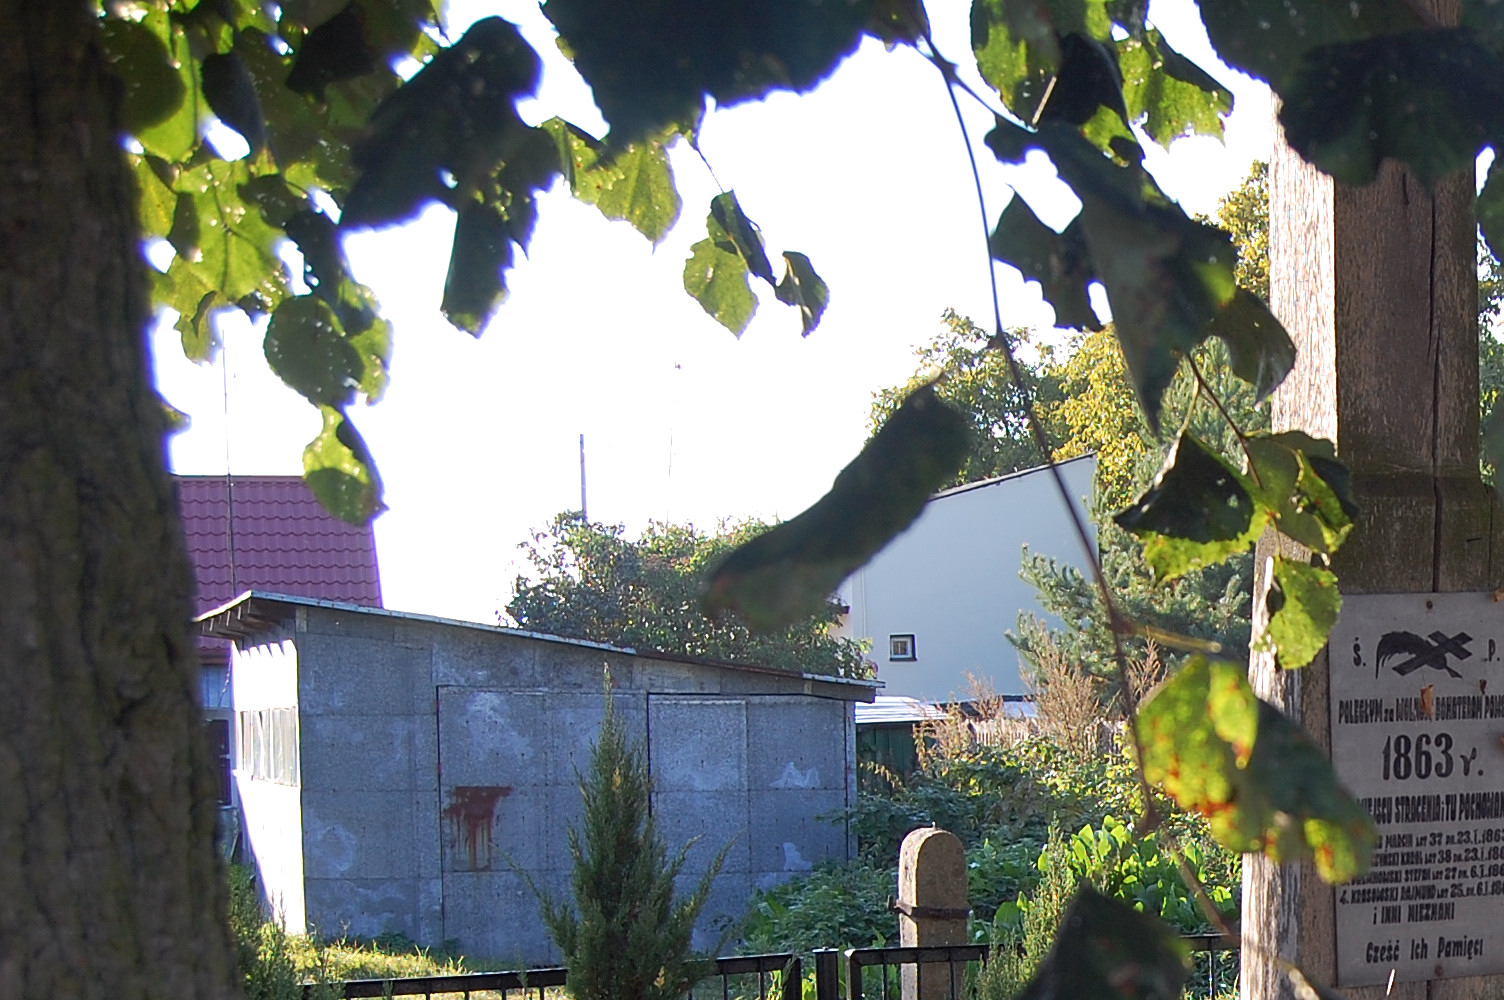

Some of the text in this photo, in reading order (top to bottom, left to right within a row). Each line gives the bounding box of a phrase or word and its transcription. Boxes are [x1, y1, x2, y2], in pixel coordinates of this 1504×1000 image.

[1382, 732, 1484, 780] 1863 r.
[1410, 937, 1429, 961] Ich
